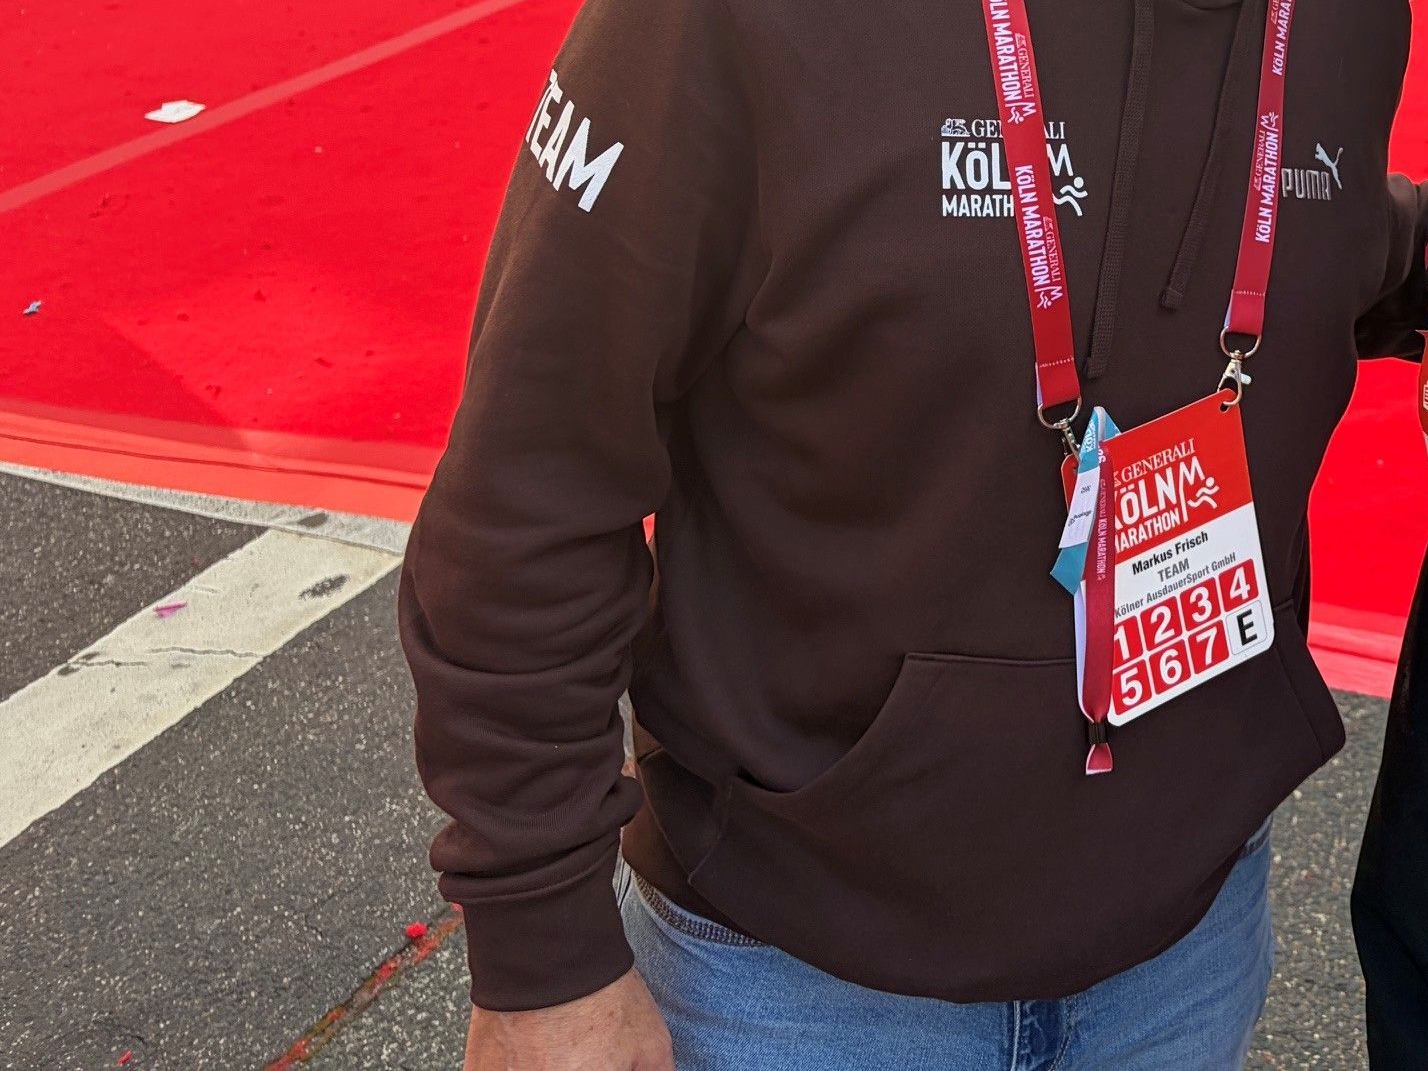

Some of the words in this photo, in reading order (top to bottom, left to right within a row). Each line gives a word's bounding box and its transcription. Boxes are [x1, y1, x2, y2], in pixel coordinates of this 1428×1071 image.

[992, 22, 1018, 106] MARATHON
[1018, 48, 1035, 99] GENERALI
[1272, 40, 1287, 76] KÖLN
[941, 142, 1012, 190] KÖL
[1256, 131, 1266, 177] GENERALI
[1262, 131, 1279, 206] MARATHON
[942, 194, 1015, 217] MARATH
[1015, 165, 1038, 204] KÖLN
[1281, 167, 1332, 201] PUMA
[1022, 207, 1051, 287] MARATHON
[1255, 205, 1272, 243] KÖLN
[1046, 231, 1062, 282] GENERALI
[1121, 438, 1196, 482] GENERALI
[1132, 546, 1173, 575] Markus
[1175, 531, 1209, 555] Frisch
[1158, 558, 1190, 582] TEAM
[1115, 599, 1144, 619] Kölner
[1146, 565, 1210, 603] AusdauerSport
[1212, 552, 1236, 572] GmbH
[1114, 625, 1131, 660] 1
[1151, 605, 1175, 645] 2
[1189, 586, 1212, 622] 3
[1229, 566, 1251, 601] 4
[1120, 667, 1143, 706] 5
[1159, 648, 1182, 685] 6
[1196, 627, 1218, 666] 7
[1236, 609, 1258, 646] E
